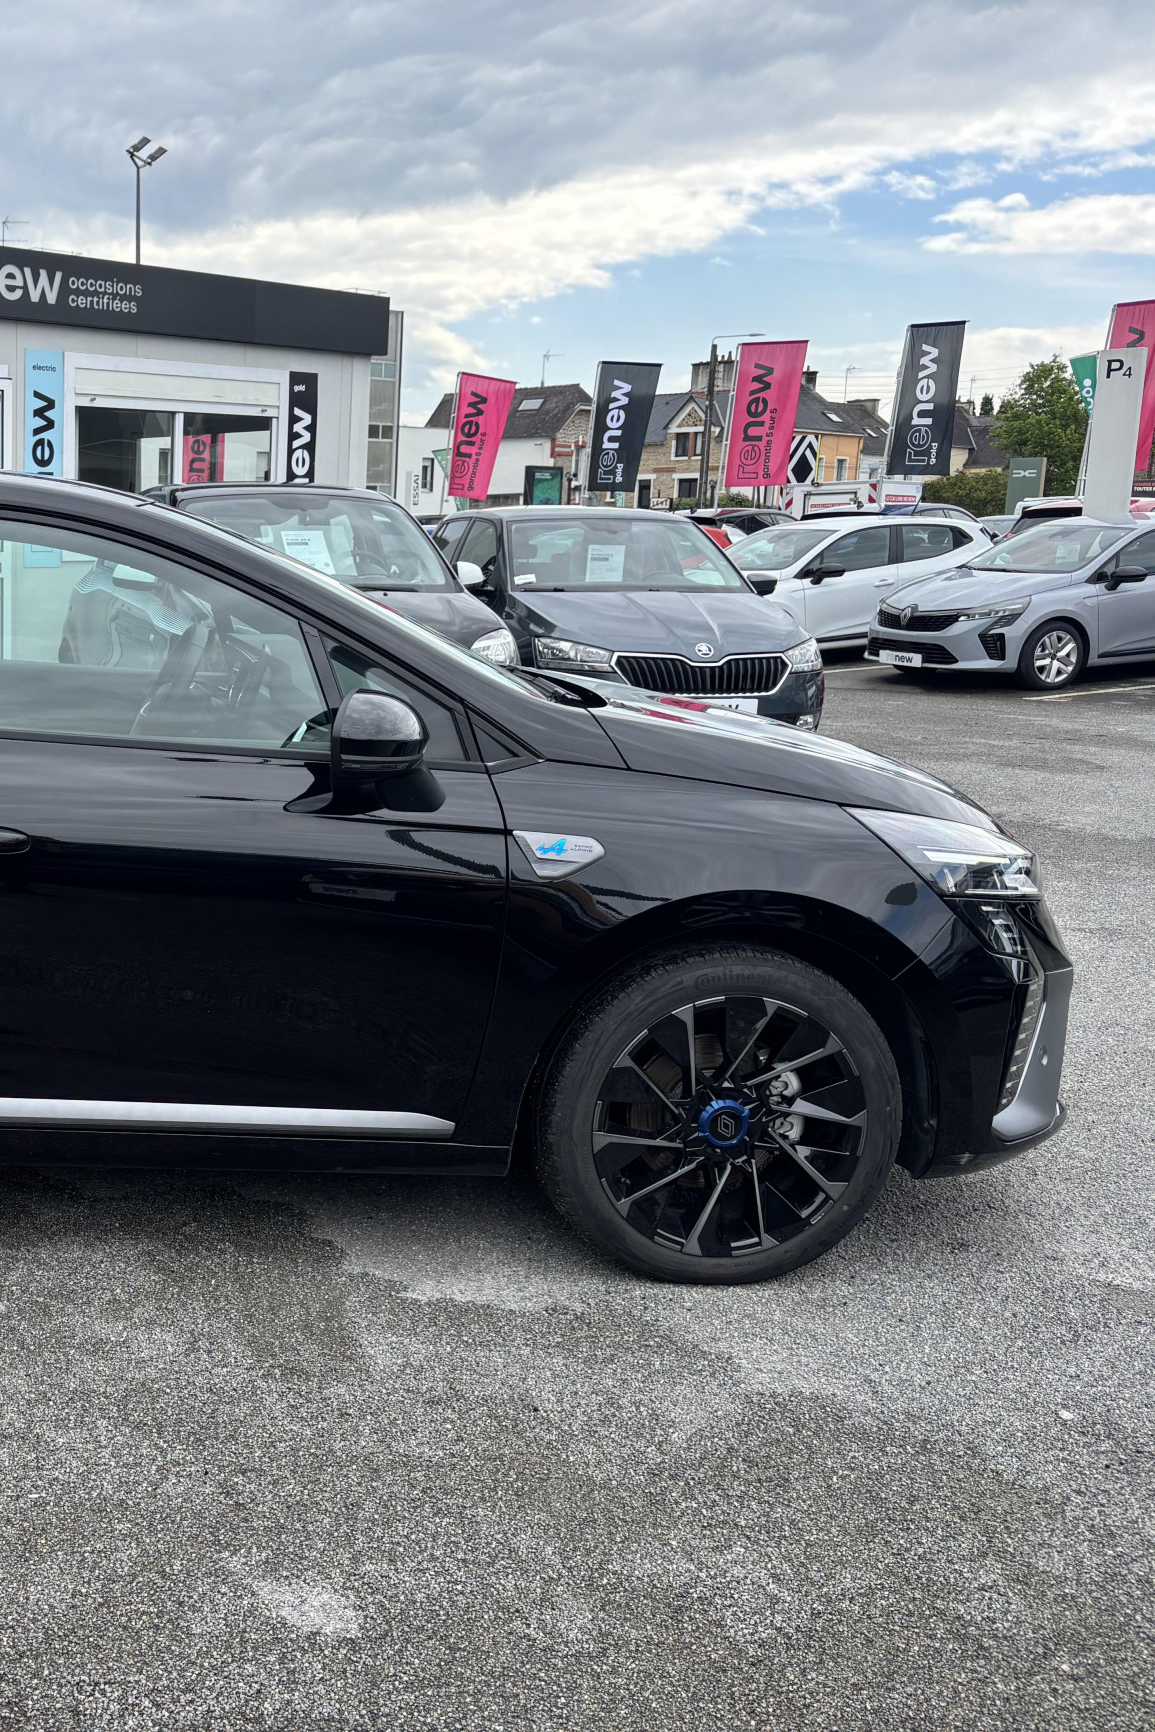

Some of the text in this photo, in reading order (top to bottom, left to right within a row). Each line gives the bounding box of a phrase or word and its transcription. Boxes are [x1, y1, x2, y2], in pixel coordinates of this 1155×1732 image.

[68, 276, 143, 297] occasions
[68, 293, 138, 314] certifiées
[32, 363, 57, 373] electric
[293, 384, 306, 393] gold
[597, 379, 632, 483] renew
[737, 362, 775, 480] renew
[905, 343, 939, 465] renew
[32, 389, 56, 477] ew
[291, 406, 312, 483] ew
[450, 391, 488, 491] renew
[762, 440, 772, 479] garantie
[768, 416, 776, 431] sur
[929, 442, 939, 465] gold
[412, 474, 420, 506] ESSAI
[467, 458, 480, 492] garantie
[478, 437, 486, 451] sur
[615, 463, 624, 483] gold
